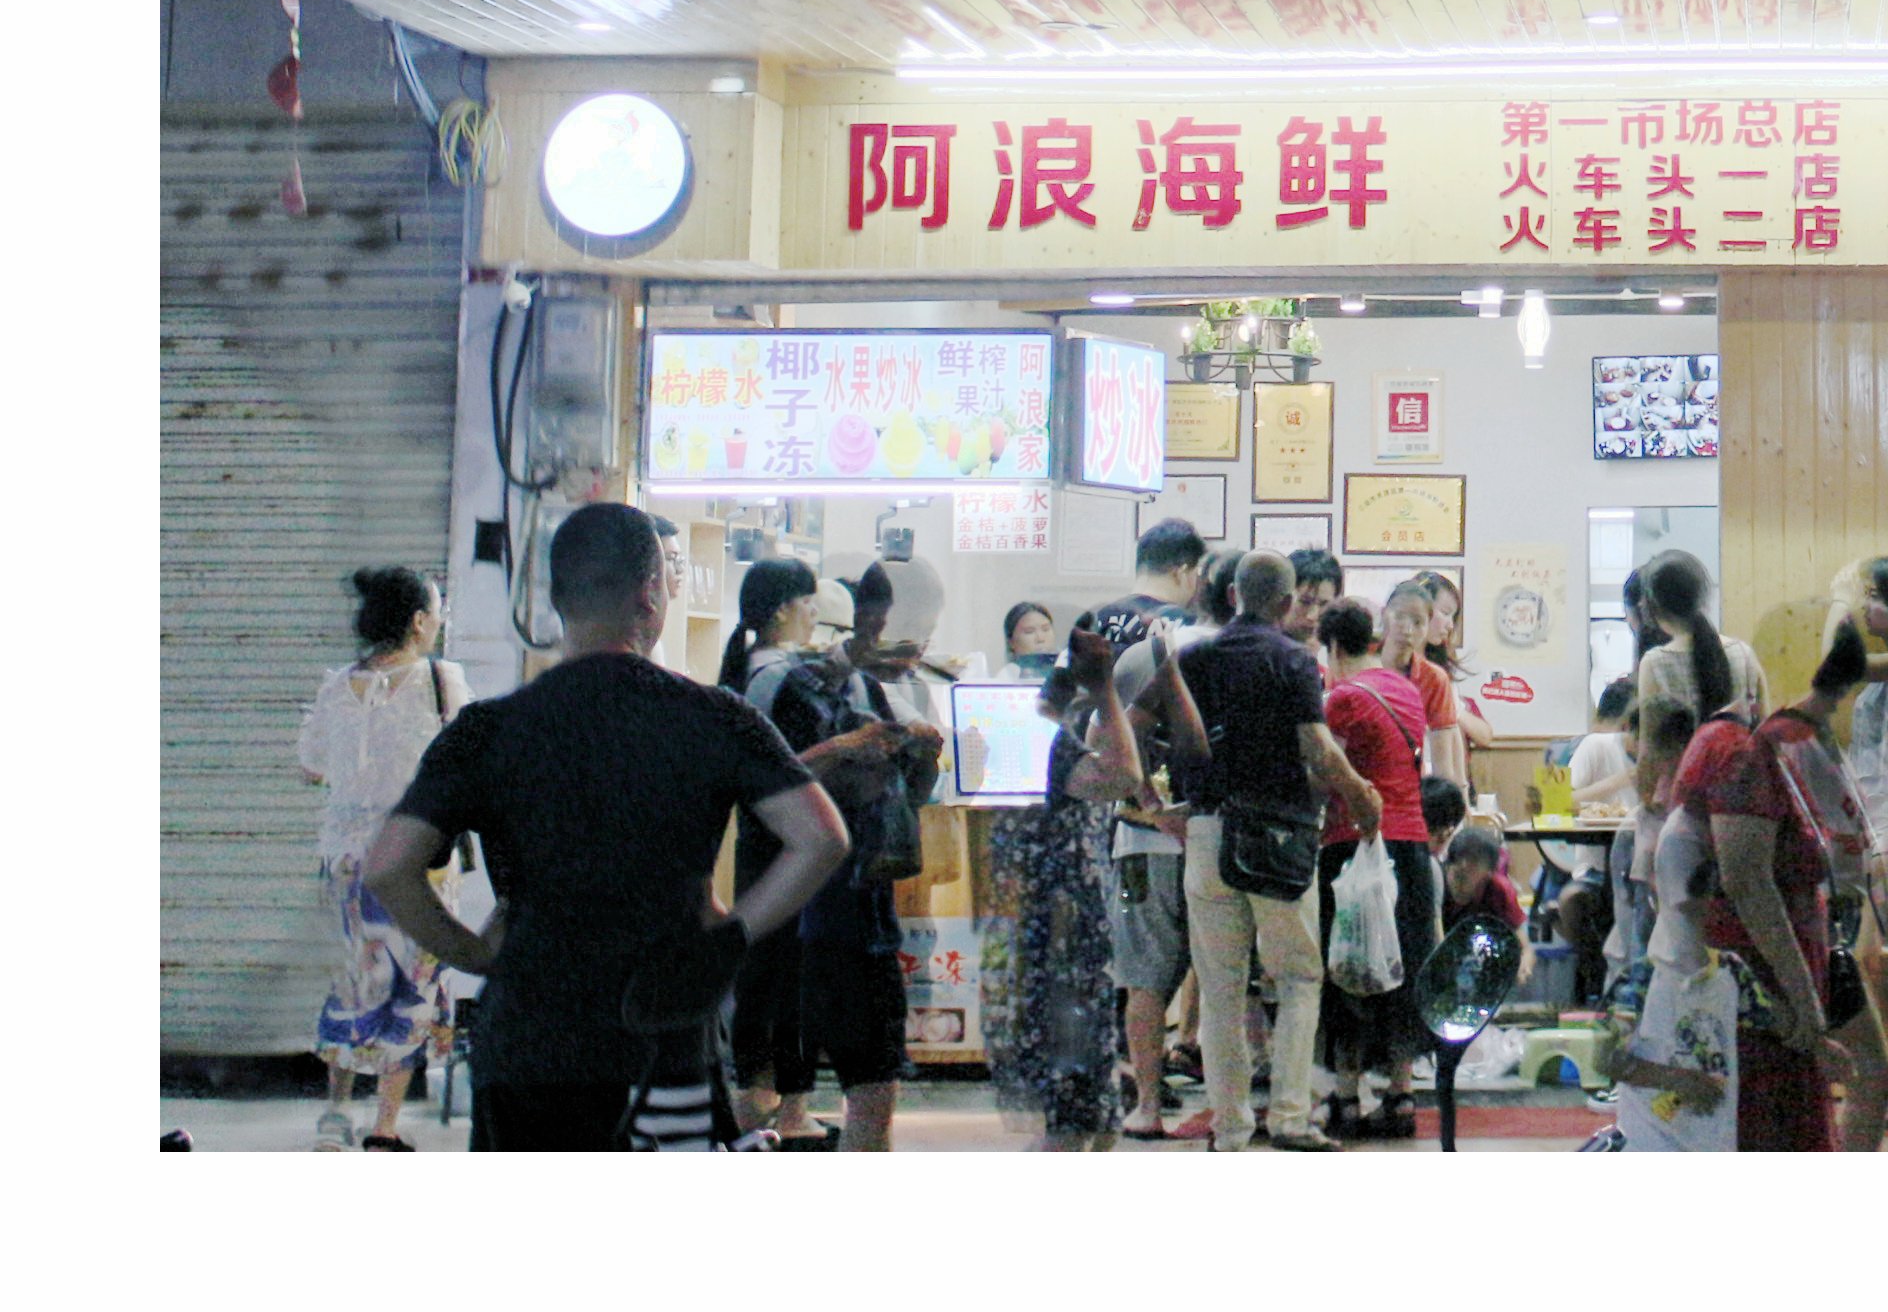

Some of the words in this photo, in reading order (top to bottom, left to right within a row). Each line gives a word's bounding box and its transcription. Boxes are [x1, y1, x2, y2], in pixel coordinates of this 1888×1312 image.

[1500, 99, 1842, 149] 第一市场总店
[848, 116, 1388, 231] 阿浪海鲜
[1499, 153, 1842, 201] 火车头一店
[1499, 206, 1842, 253] 火车头二店
[661, 367, 764, 405] 柠檬水
[824, 344, 923, 414] 水果炒冰
[762, 340, 821, 477] 椰子冻
[1017, 343, 1046, 473] 阿浪家
[1088, 348, 1161, 483] 炒冰
[1396, 397, 1423, 425] 信
[958, 489, 1049, 514] 柠檬水
